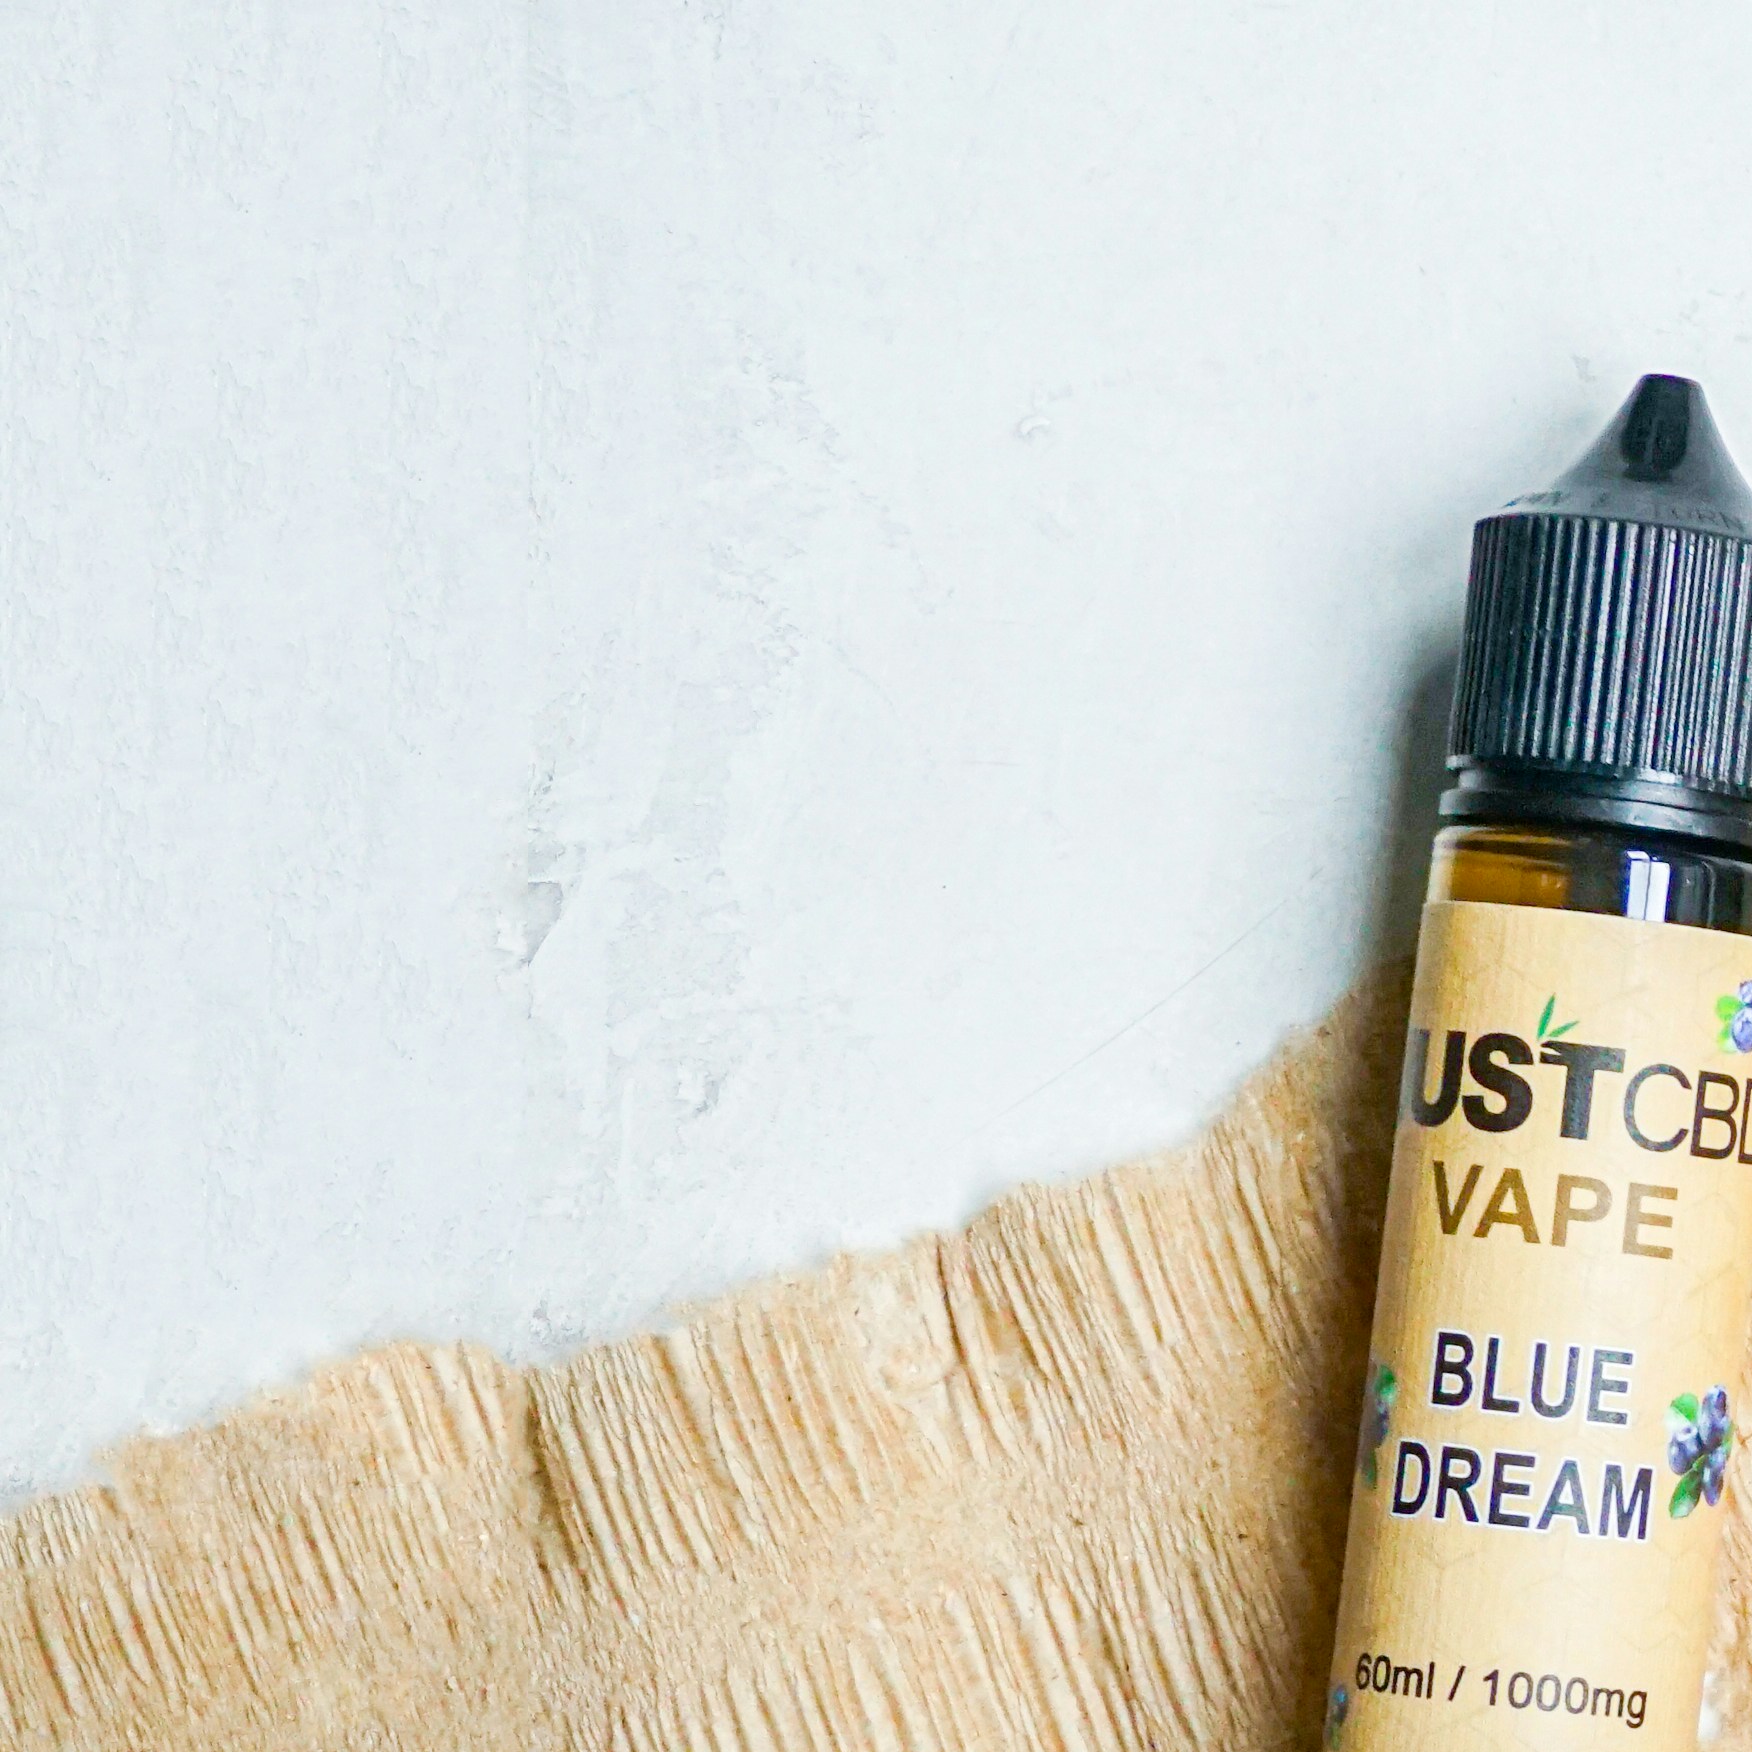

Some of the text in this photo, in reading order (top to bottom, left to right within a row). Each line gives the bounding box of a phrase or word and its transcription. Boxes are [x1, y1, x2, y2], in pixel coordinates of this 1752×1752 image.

[1432, 1159, 1680, 1261] VAPE
[1430, 1329, 1637, 1427] BLUE
[1391, 1439, 1655, 1542] DREAM
[1355, 1652, 1650, 1730] 60ml / 1000mg
